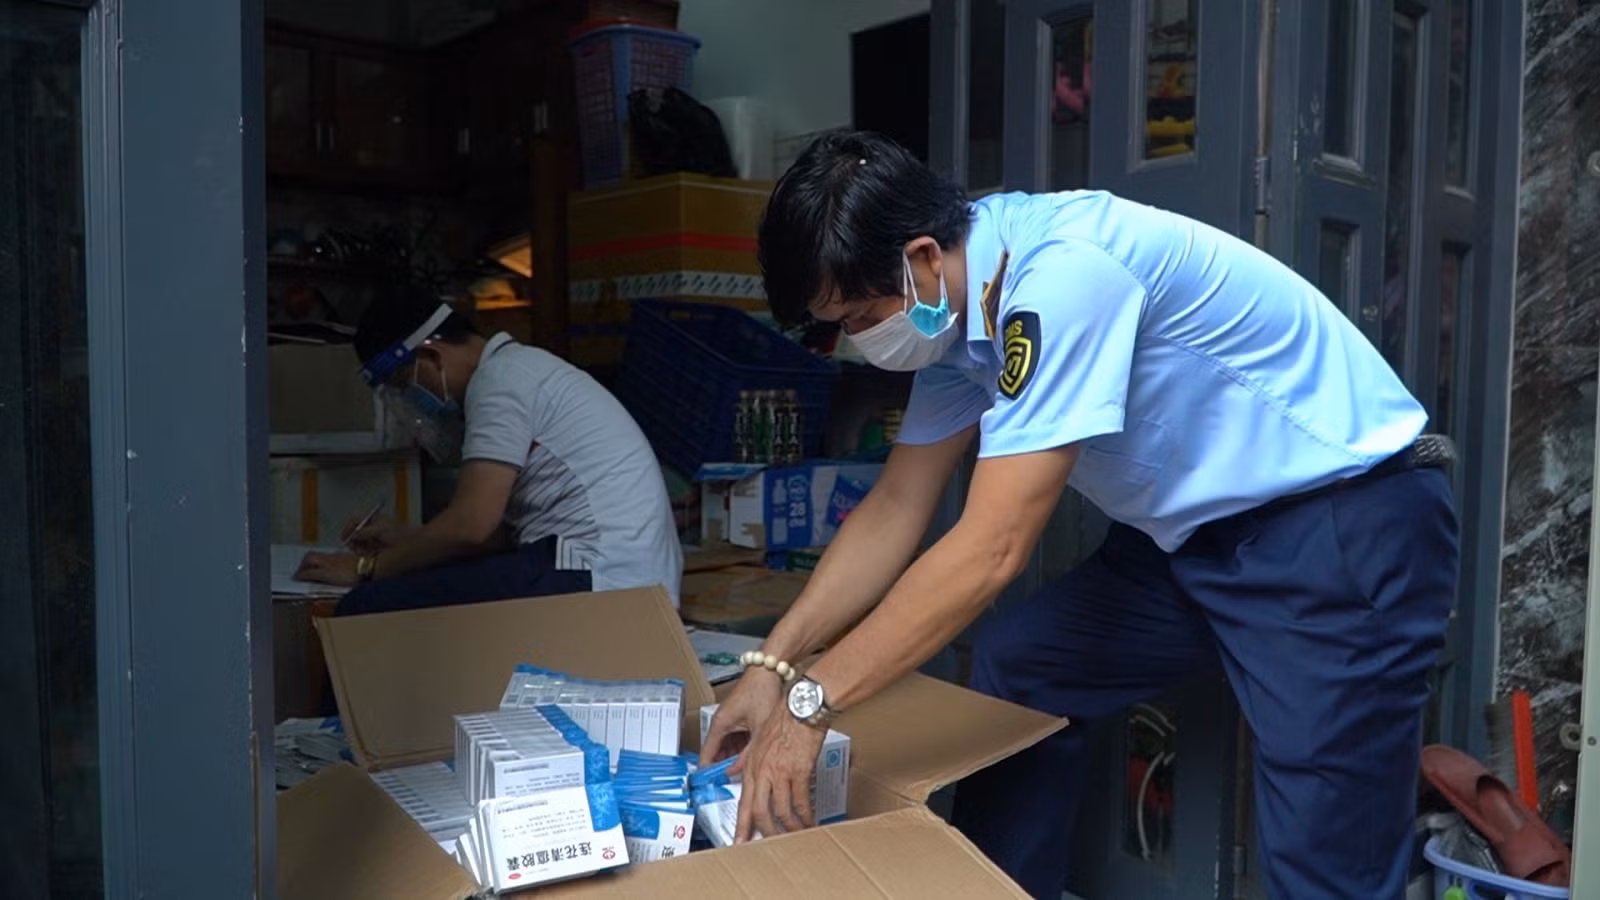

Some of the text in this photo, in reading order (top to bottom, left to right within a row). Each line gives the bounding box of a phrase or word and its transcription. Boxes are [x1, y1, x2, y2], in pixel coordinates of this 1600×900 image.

[789, 502, 806, 517] 28
[506, 841, 592, 871] 连花清瘟胶囊
